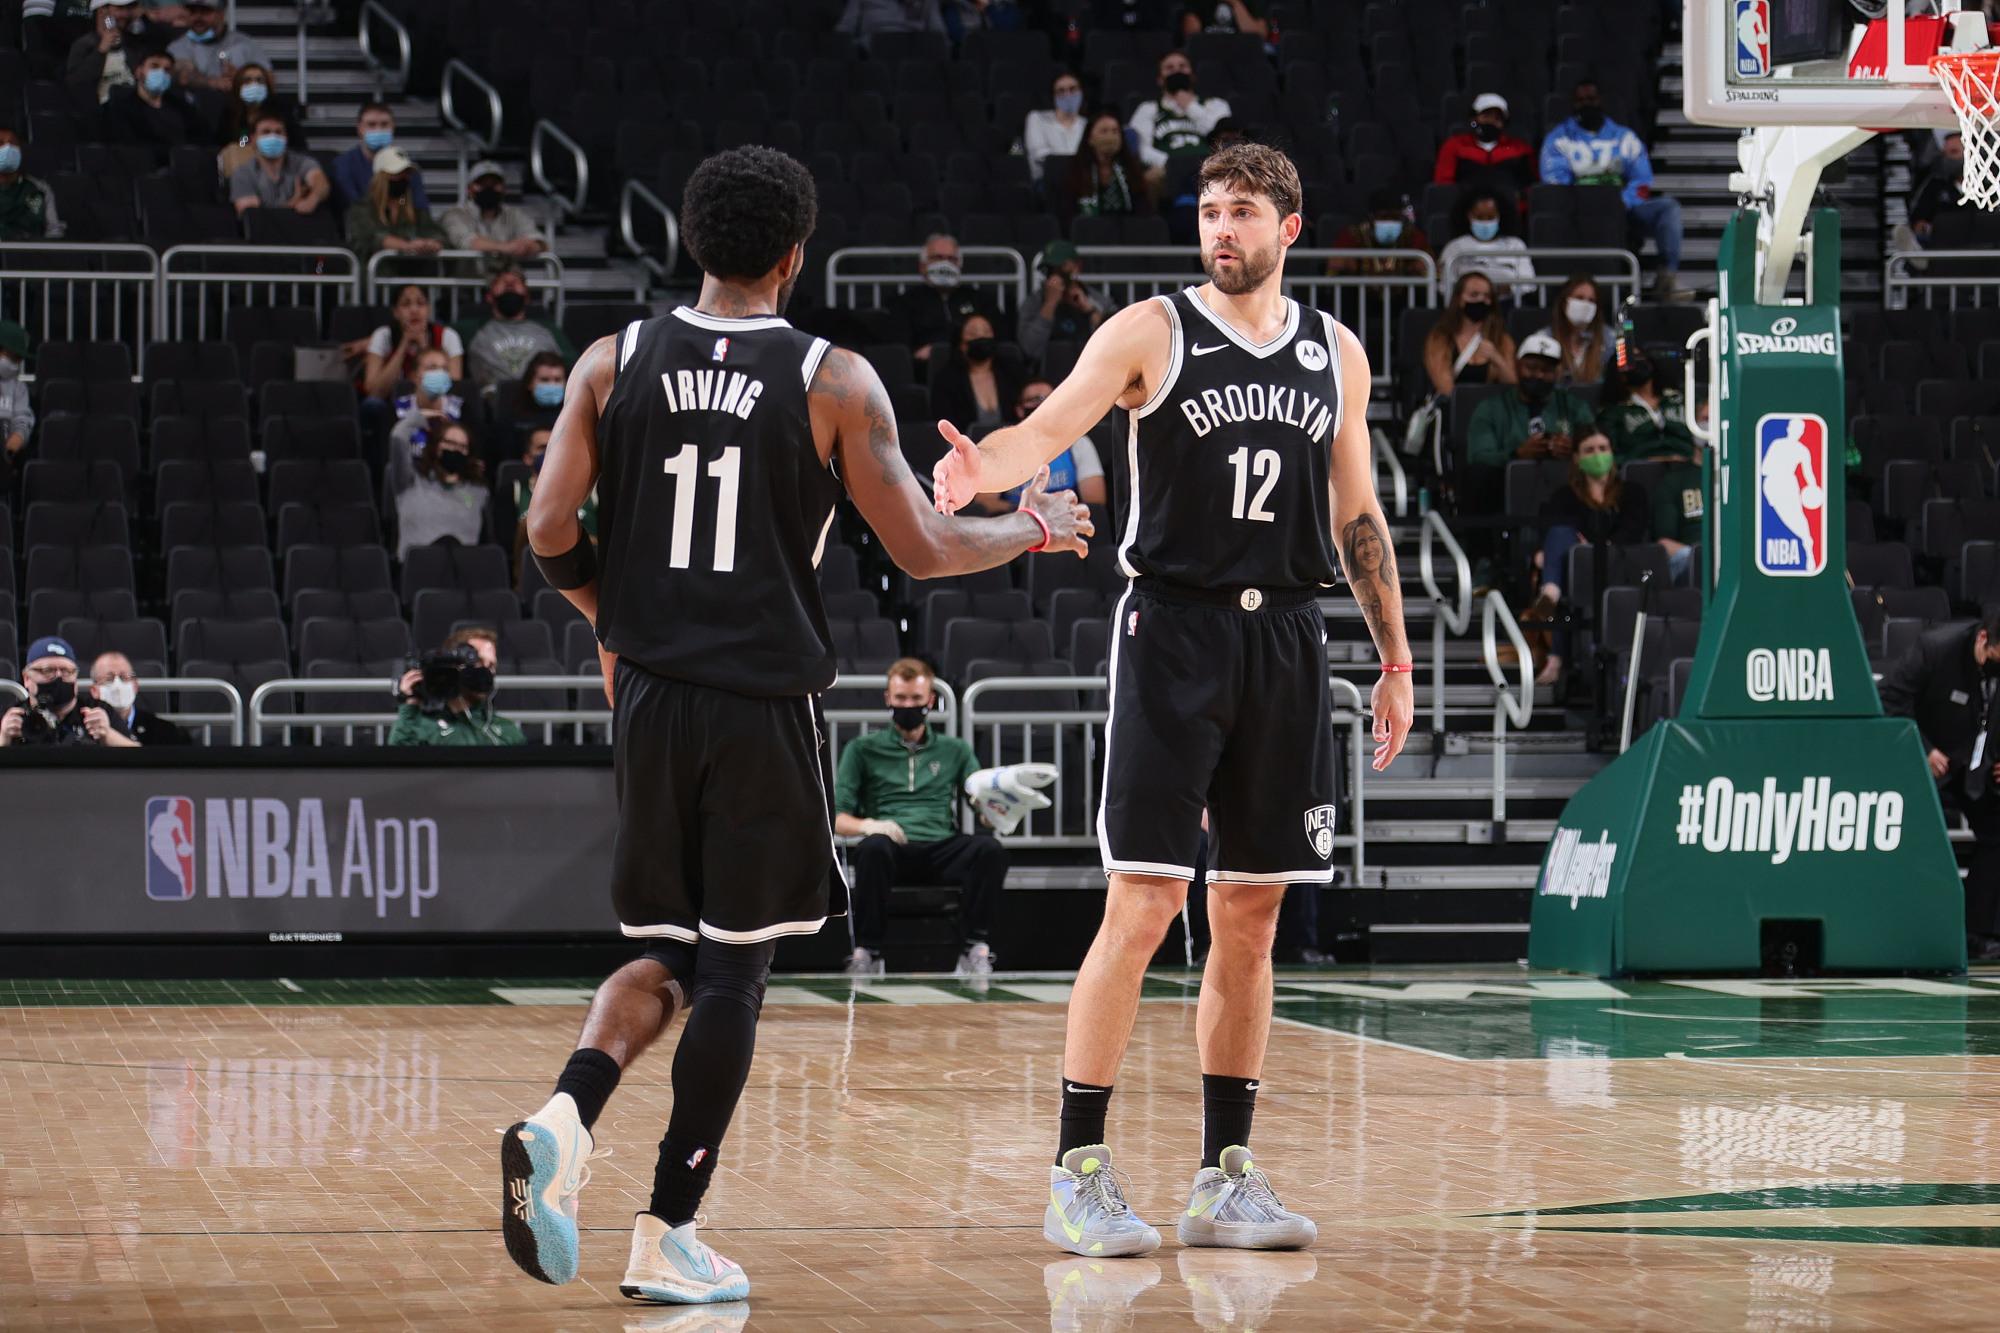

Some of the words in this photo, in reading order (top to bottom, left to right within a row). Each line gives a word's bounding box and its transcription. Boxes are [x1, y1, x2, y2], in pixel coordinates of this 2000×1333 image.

[1726, 90, 1779, 102] SPALDING
[1737, 332, 1836, 355] SPALDING
[661, 369, 764, 420] IRVING
[1180, 383, 1333, 444] BROOKLYN
[664, 443, 741, 571] 11
[1228, 446, 1282, 522] 12
[1766, 538, 1801, 566] NBA
[1746, 648, 1835, 702] @NBA
[1307, 808, 1336, 833] NETS
[1676, 776, 1904, 865] #OnlyHere
[205, 798, 333, 898] NBA
[340, 798, 439, 918] App
